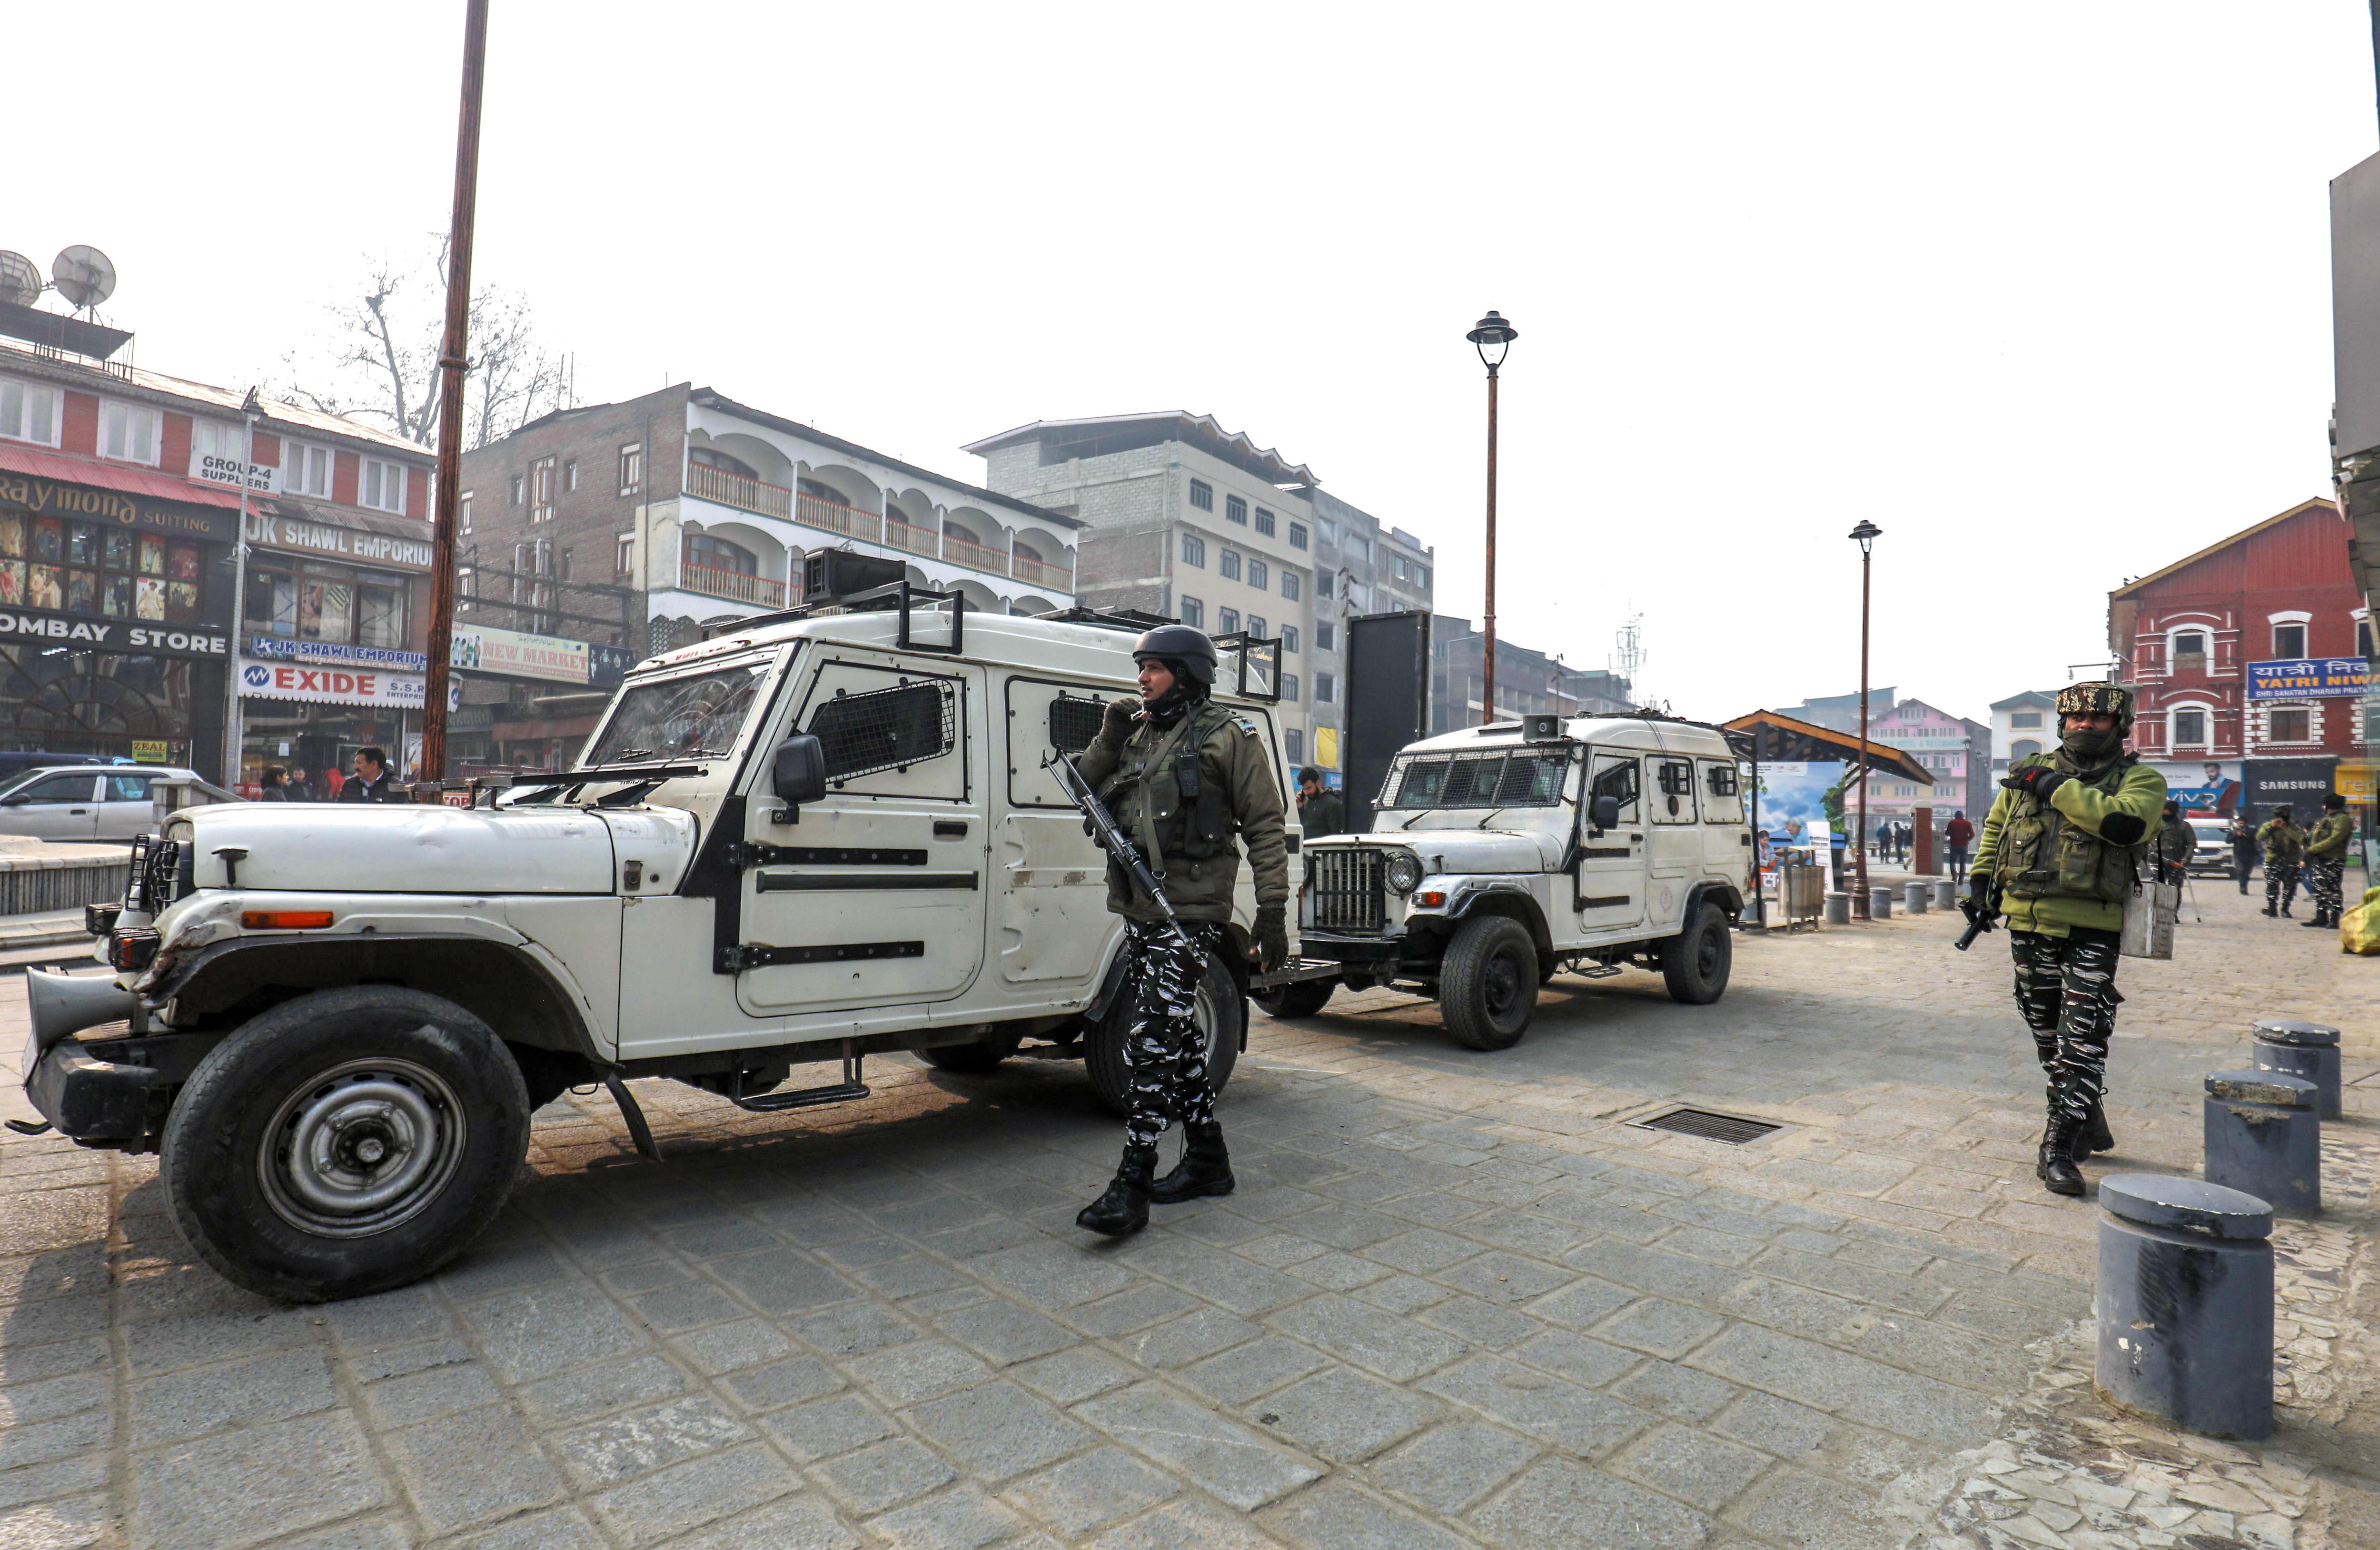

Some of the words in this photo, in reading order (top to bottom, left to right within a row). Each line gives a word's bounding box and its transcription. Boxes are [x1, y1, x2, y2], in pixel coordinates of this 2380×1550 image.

[203, 456, 271, 479] GROUP-4
[201, 469, 269, 490] SUPPLERS
[144, 512, 209, 532] SUITING
[246, 516, 278, 545] JK
[286, 524, 348, 553] SHAWL
[129, 628, 226, 654] STORE
[275, 640, 296, 654] JK
[300, 643, 351, 659] SHAWL
[356, 648, 427, 665] EMPORIUM
[298, 656, 355, 666] ENTRANCE
[482, 642, 519, 661] NEW
[522, 647, 588, 670] MARKET
[2252, 663, 2318, 676] यात्री
[275, 668, 376, 696] EXIDE
[2256, 677, 2320, 689] YATRI
[133, 742, 166, 751] ZEAL
[2259, 780, 2327, 790] SAMSUNG
[2166, 790, 2217, 804] vivo
